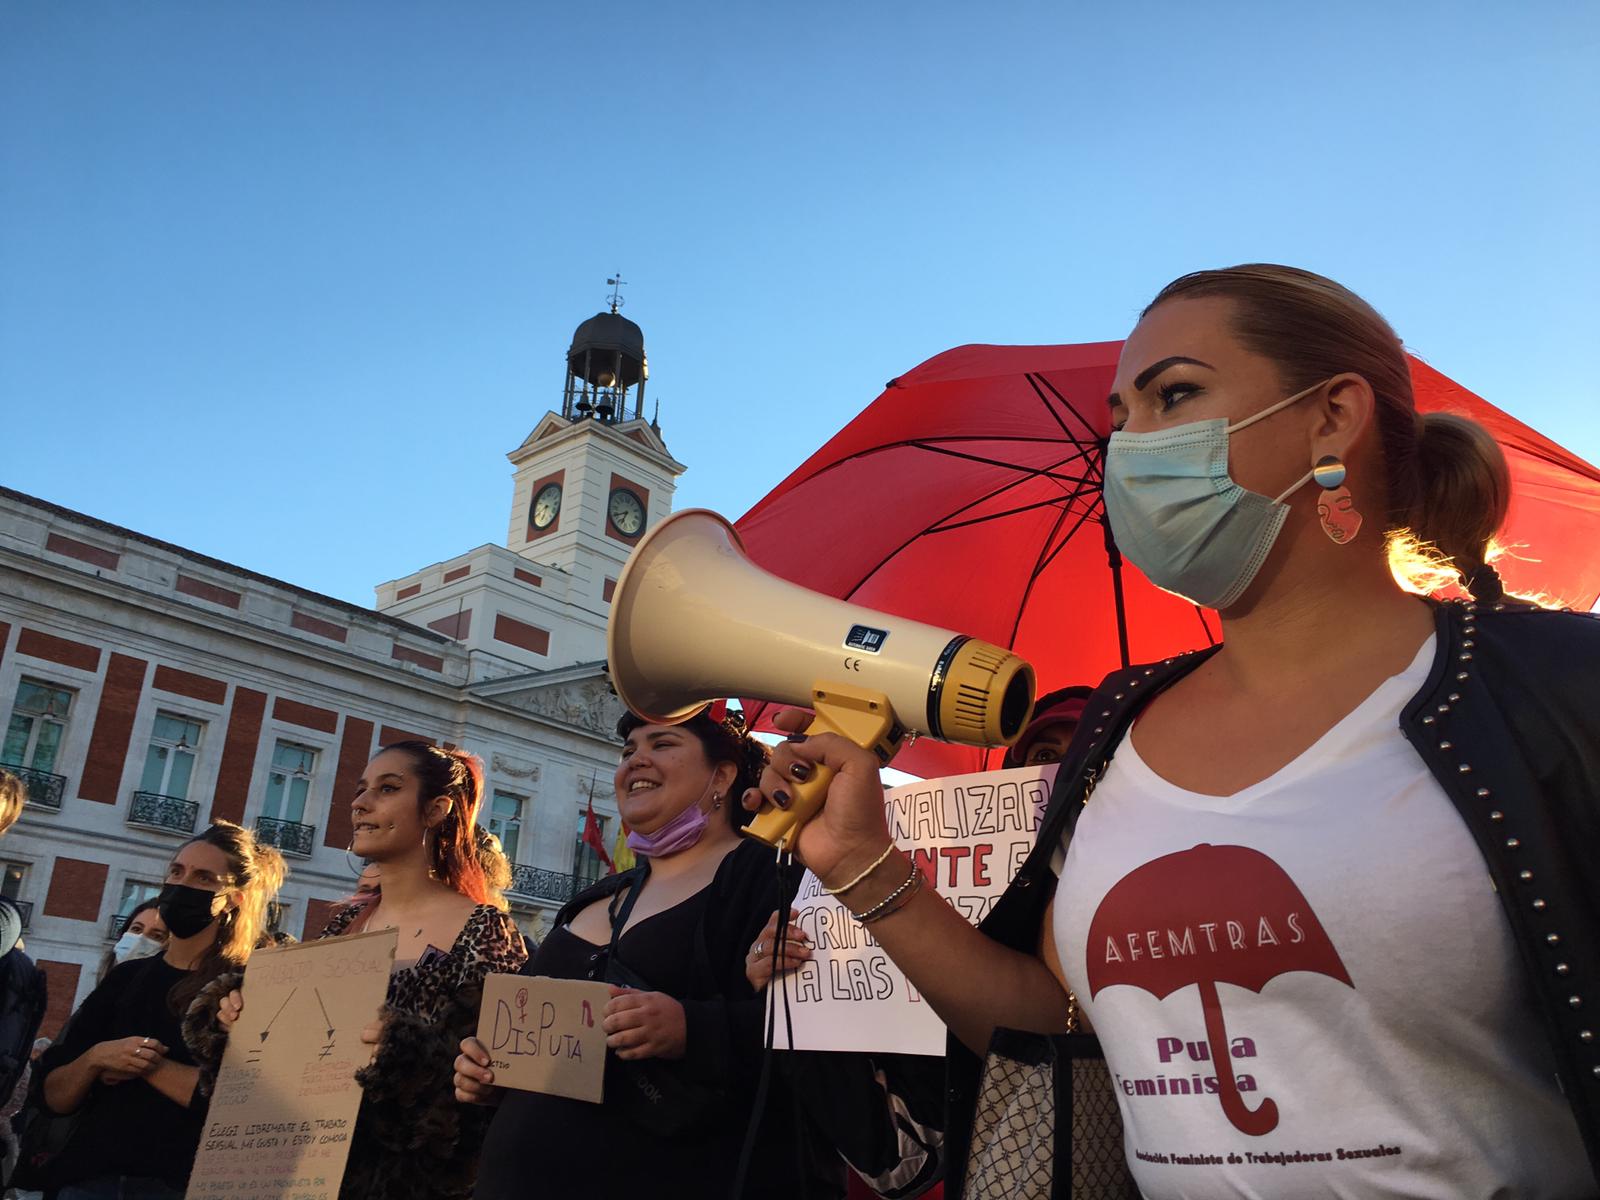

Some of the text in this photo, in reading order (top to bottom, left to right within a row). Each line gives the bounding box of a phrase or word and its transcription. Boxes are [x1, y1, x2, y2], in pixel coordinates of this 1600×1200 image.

[844, 656, 862, 672] CE
[1105, 912, 1305, 964] AFEMTRAS
[795, 959, 822, 1004] A
[830, 956, 895, 1002] LAS
[245, 1122, 296, 1136] LIBREMENTE
[300, 1120, 311, 1133] EL
[315, 1118, 347, 1130] TRABAJO
[292, 1135, 316, 1146] ESTOY
[1170, 1152, 1224, 1165] Feminista
[1227, 1151, 1243, 1164] de
[1245, 1150, 1333, 1166] Trabajadoras
[1336, 1144, 1401, 1160] Sexuales
